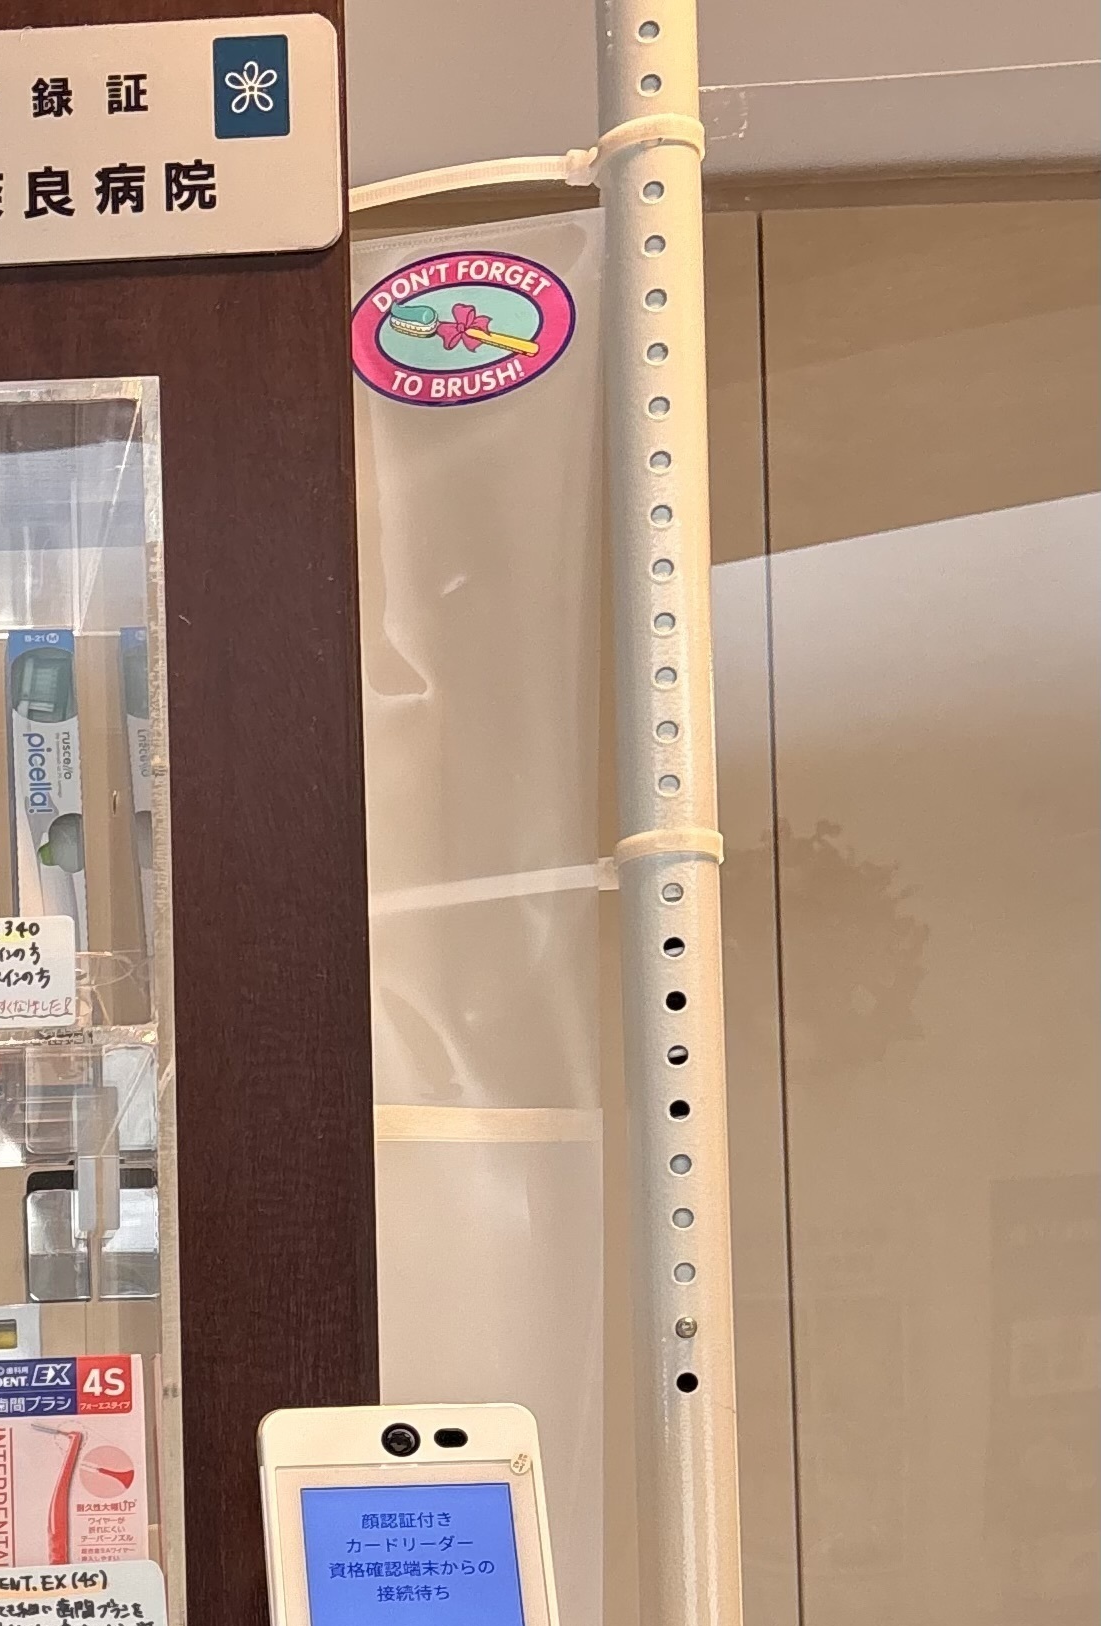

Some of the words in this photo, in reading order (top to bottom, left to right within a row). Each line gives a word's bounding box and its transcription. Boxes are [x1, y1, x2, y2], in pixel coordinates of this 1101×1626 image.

[372, 263, 450, 313] DON'T
[457, 259, 552, 297] FORGET
[391, 370, 423, 396] TO
[430, 358, 525, 399] BRUSH!
[25, 634, 46, 643] B-21
[23, 732, 53, 815] picella!
[82, 1367, 126, 1397] 4S
[361, 1512, 452, 1530] 顔認証付き
[346, 1535, 474, 1553] カードリーダー
[329, 1559, 495, 1580] 資格確認端末からの
[376, 1585, 451, 1603] 接続待ち
